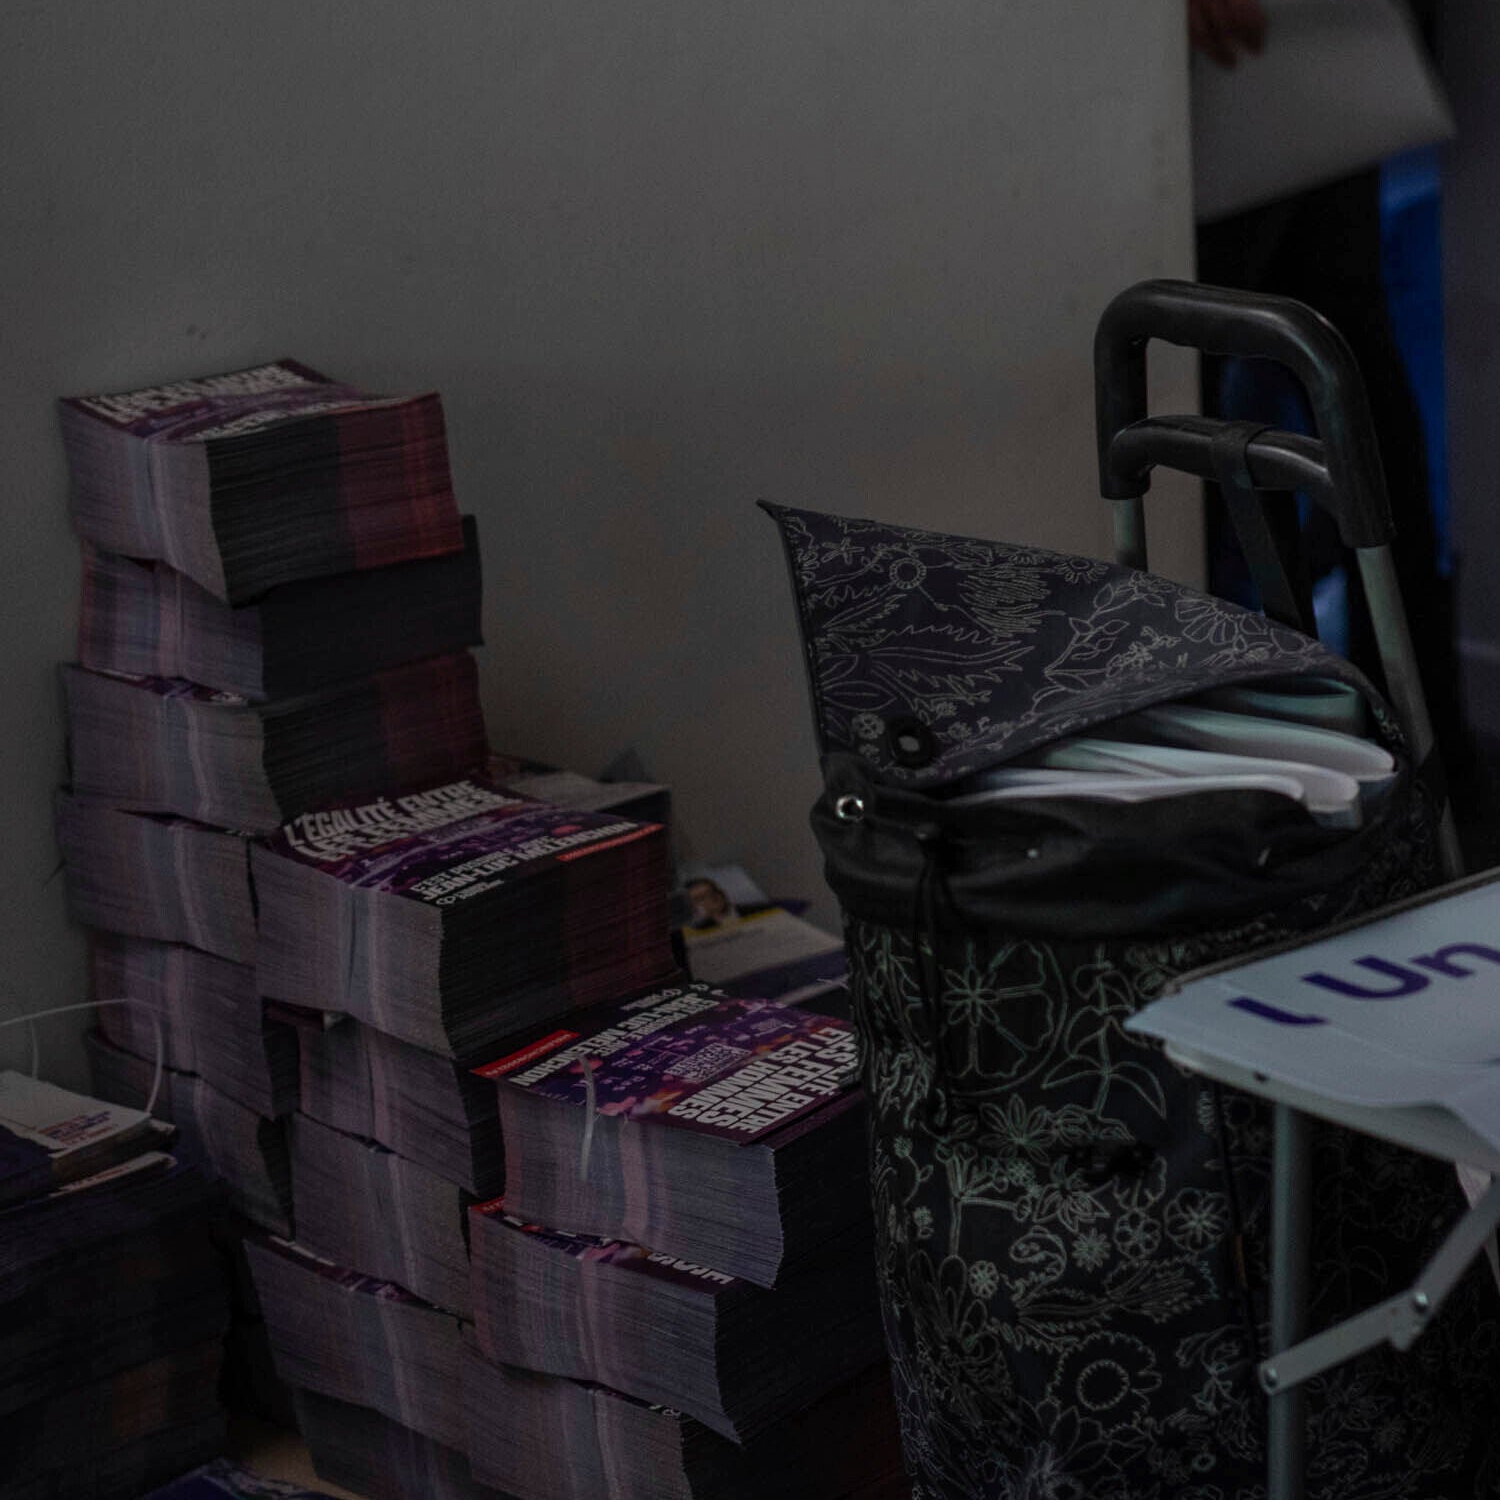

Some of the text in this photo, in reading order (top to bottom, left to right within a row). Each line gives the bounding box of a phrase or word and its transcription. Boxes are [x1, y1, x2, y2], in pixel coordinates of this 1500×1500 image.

[422, 856, 520, 901] JEAN-LUC
[667, 1060, 779, 1120] HOMMES
[696, 1059, 835, 1128] FEMMES
[727, 1092, 816, 1134] ENTRE
